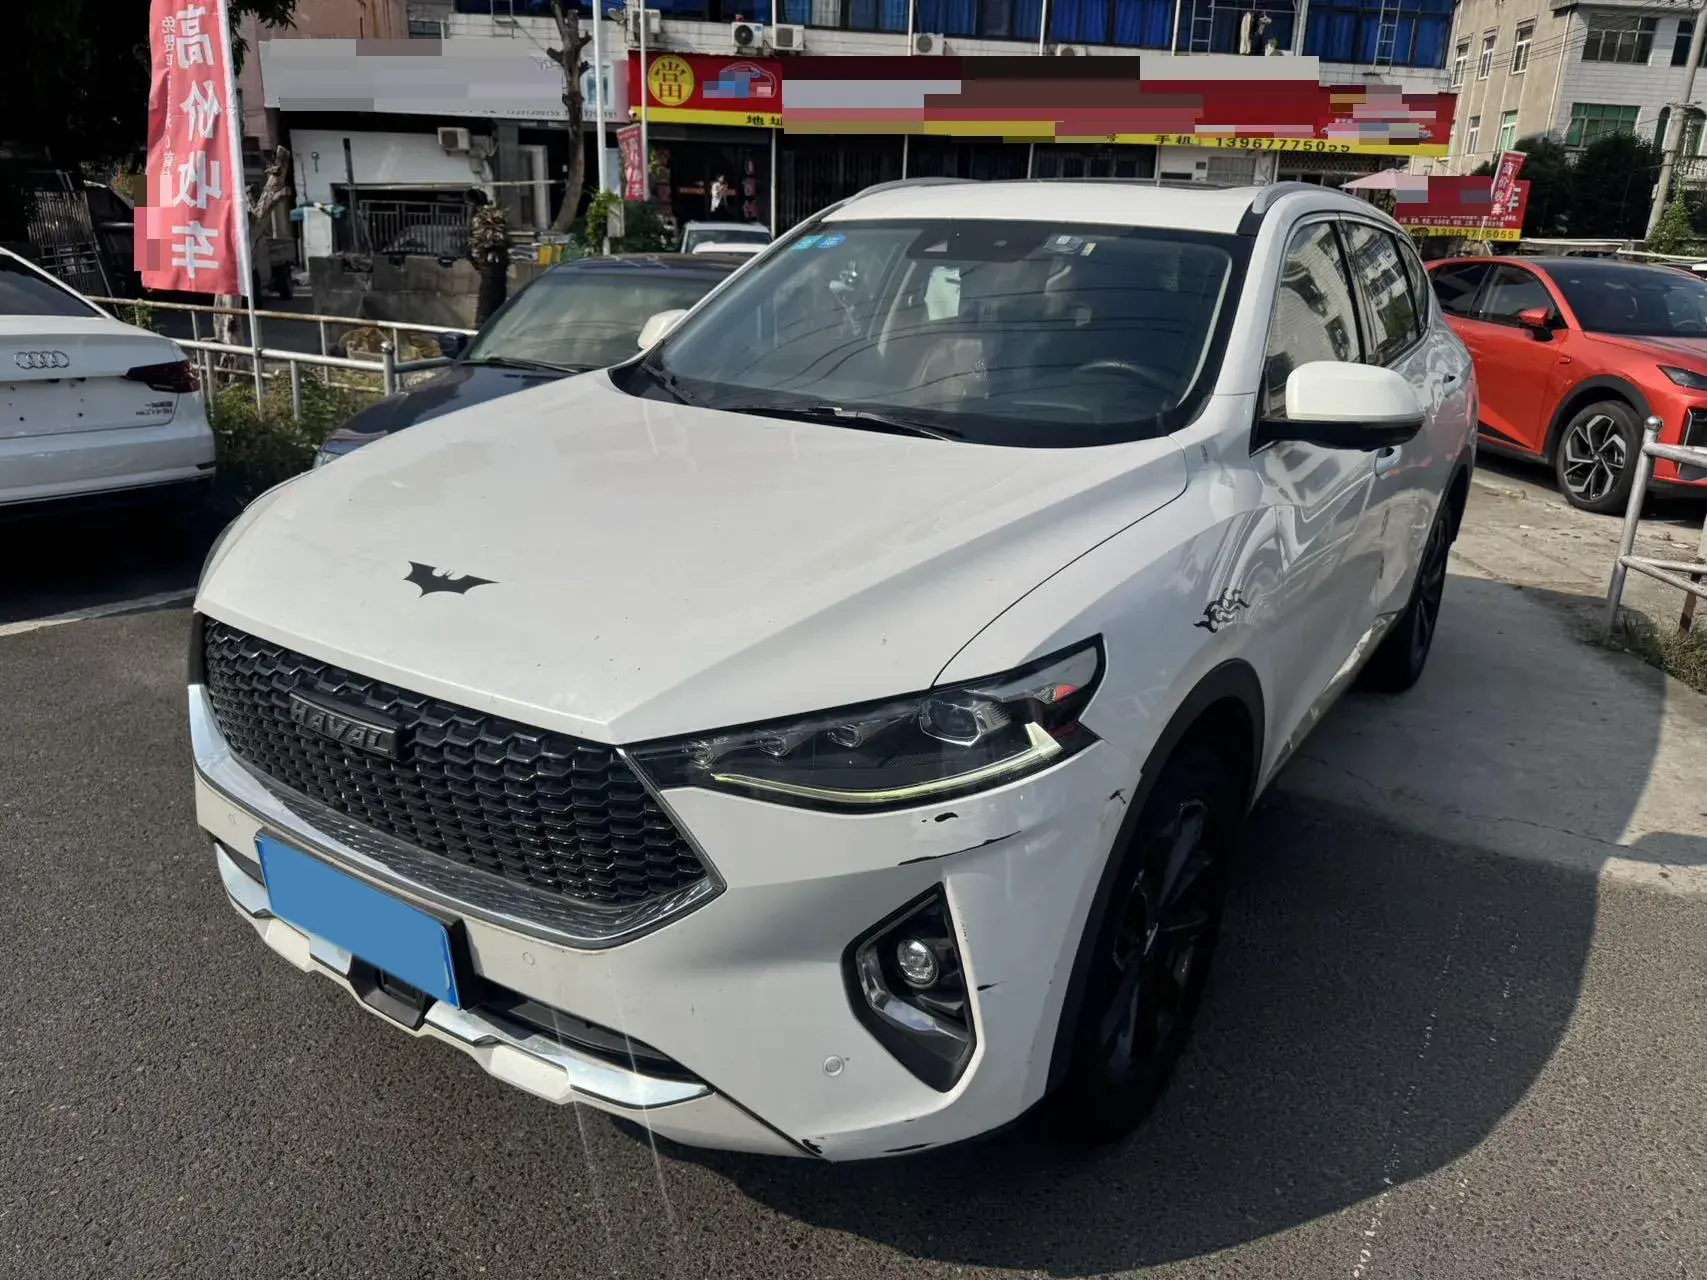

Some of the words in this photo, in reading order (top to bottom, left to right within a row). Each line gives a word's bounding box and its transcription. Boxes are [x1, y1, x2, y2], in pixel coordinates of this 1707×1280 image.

[1215, 137, 1351, 153] 13967775055
[1434, 227, 1515, 239] 1396775055
[290, 699, 391, 754] HAVAL
